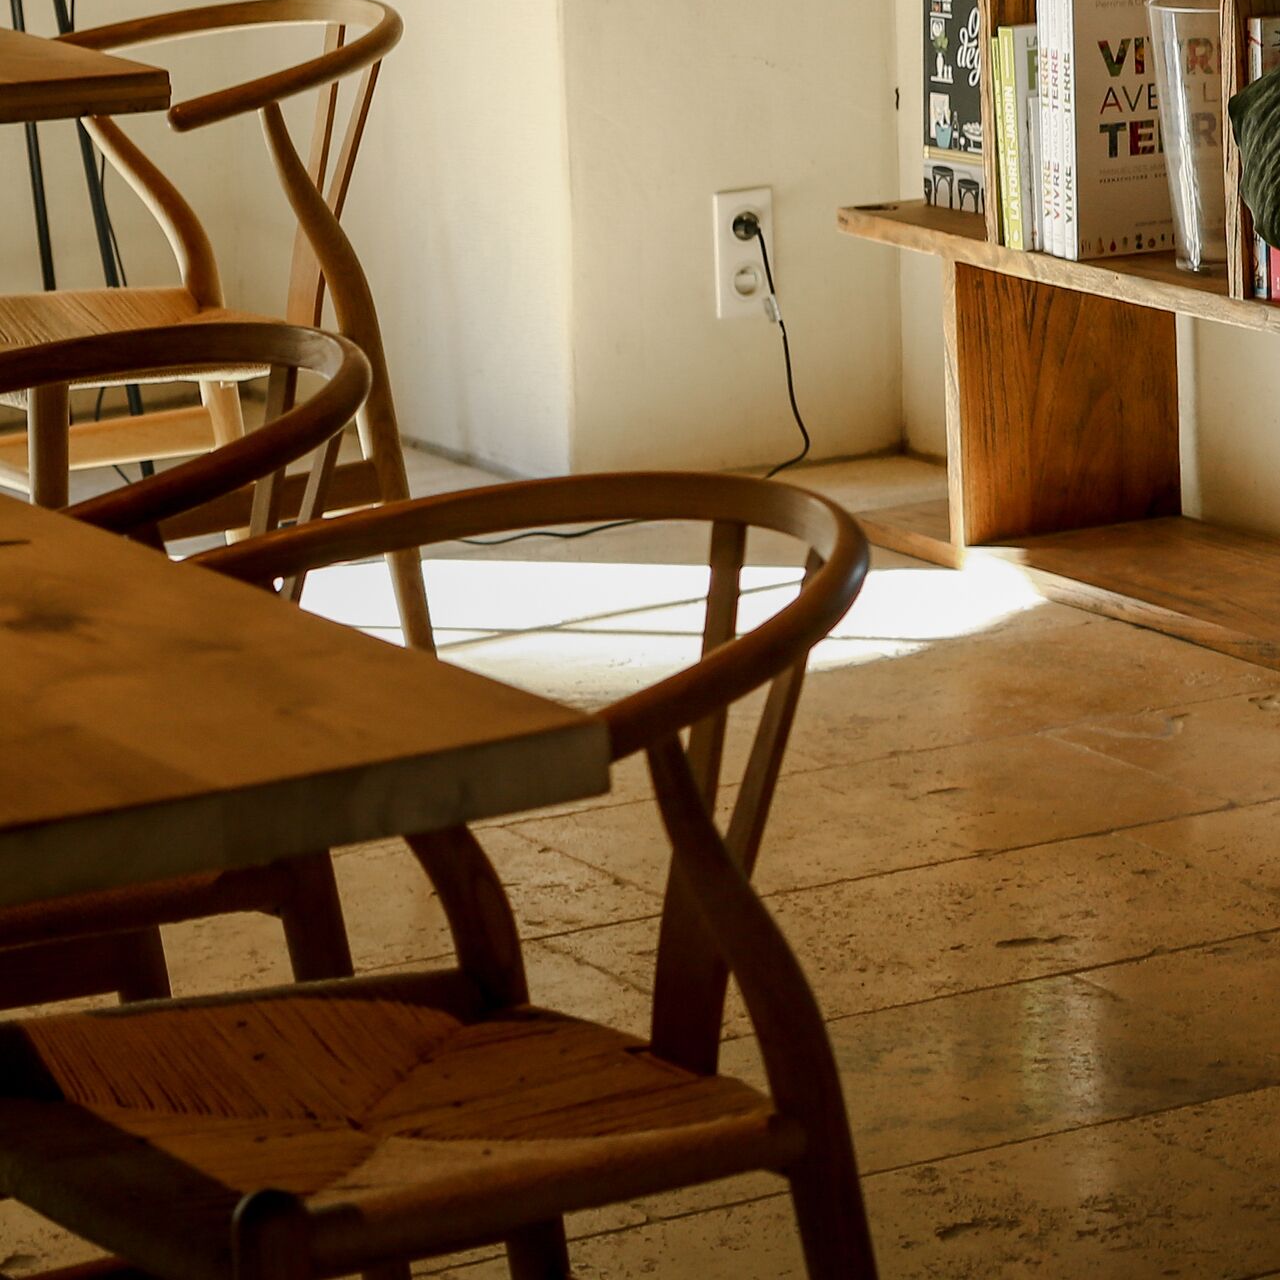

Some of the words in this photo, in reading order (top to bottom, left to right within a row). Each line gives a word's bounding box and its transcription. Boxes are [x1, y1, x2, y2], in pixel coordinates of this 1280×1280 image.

[1041, 47, 1049, 109] TERRE
[1050, 48, 1059, 111] TERRE
[1062, 51, 1071, 114] TERRE
[1010, 199, 1021, 221] LA
[1043, 160, 1051, 218] VIVRE
[1052, 161, 1061, 220] VIVRE
[1064, 165, 1073, 225] VIVRE
